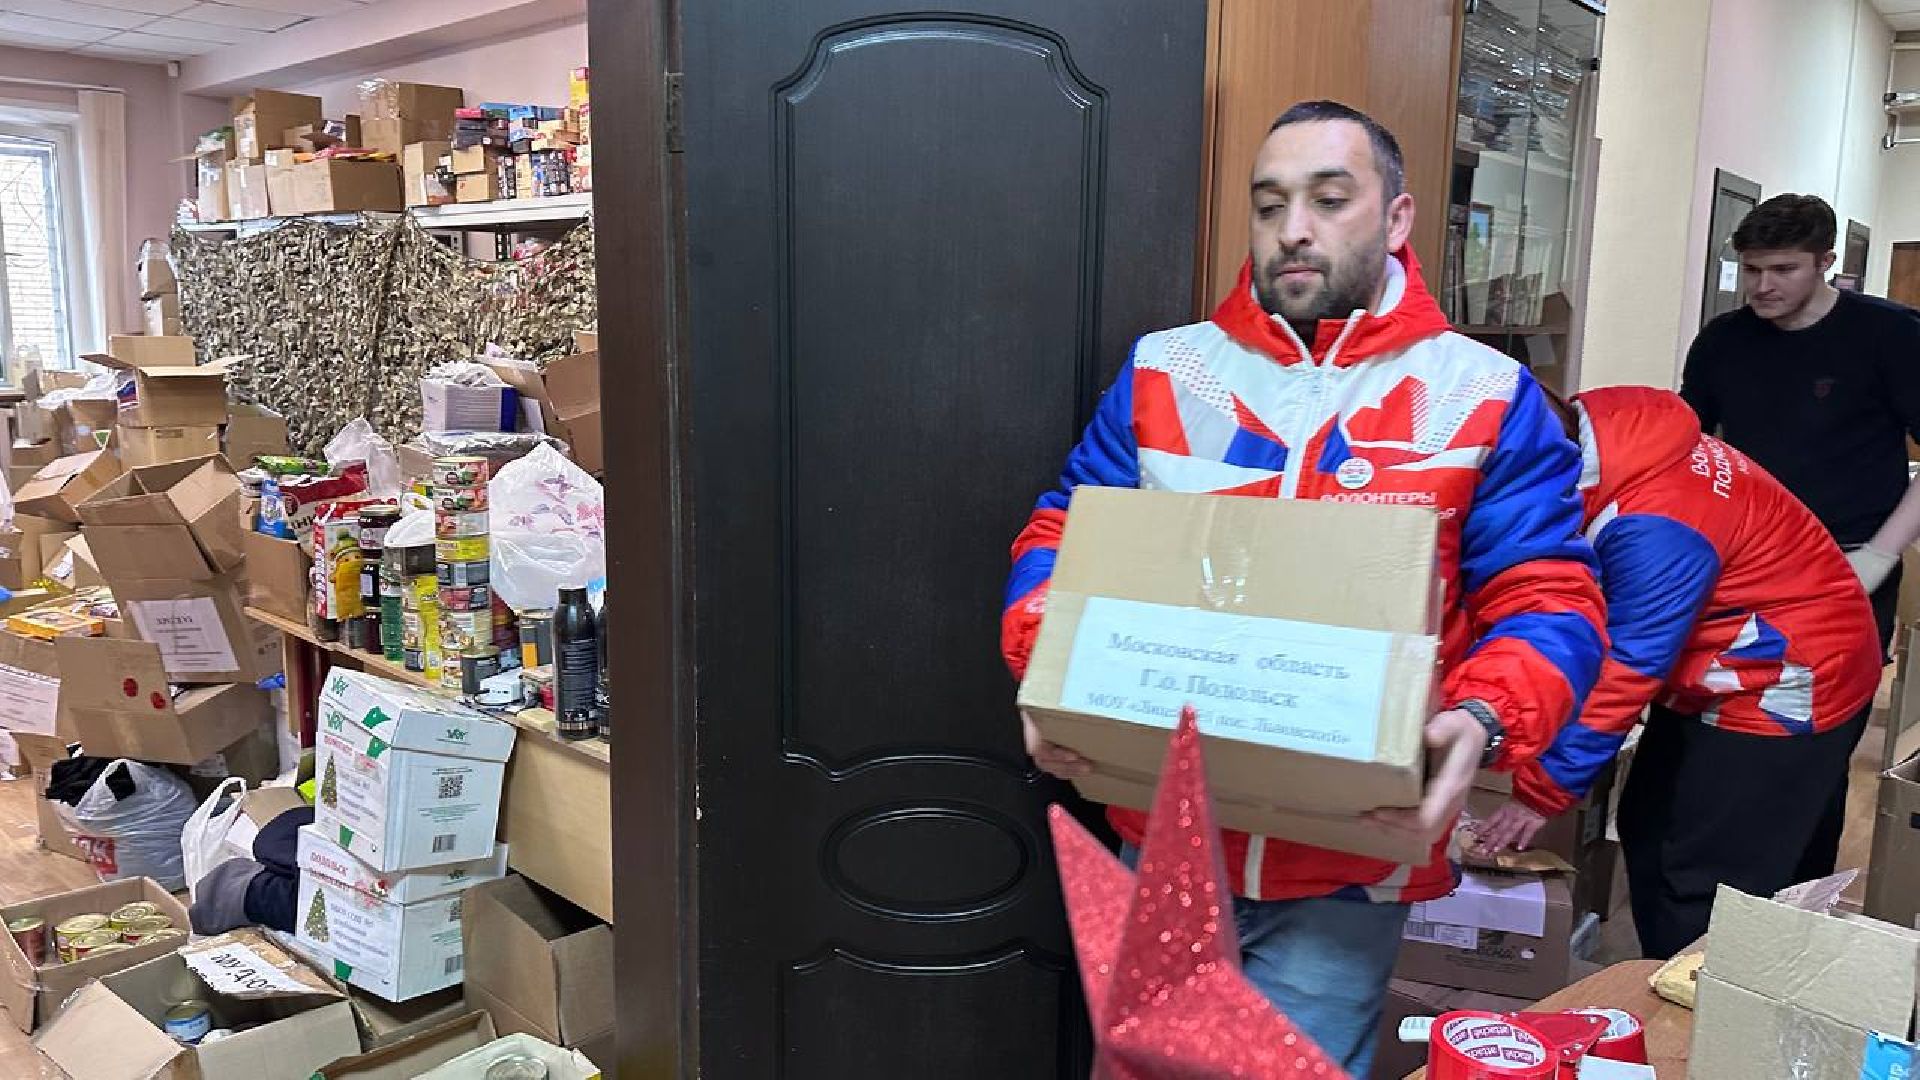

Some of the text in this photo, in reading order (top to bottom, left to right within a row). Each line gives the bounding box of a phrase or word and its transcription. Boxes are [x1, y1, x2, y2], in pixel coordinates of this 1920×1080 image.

[1106, 632, 1350, 679] Московская область
[1185, 674, 1299, 708] Подольск
